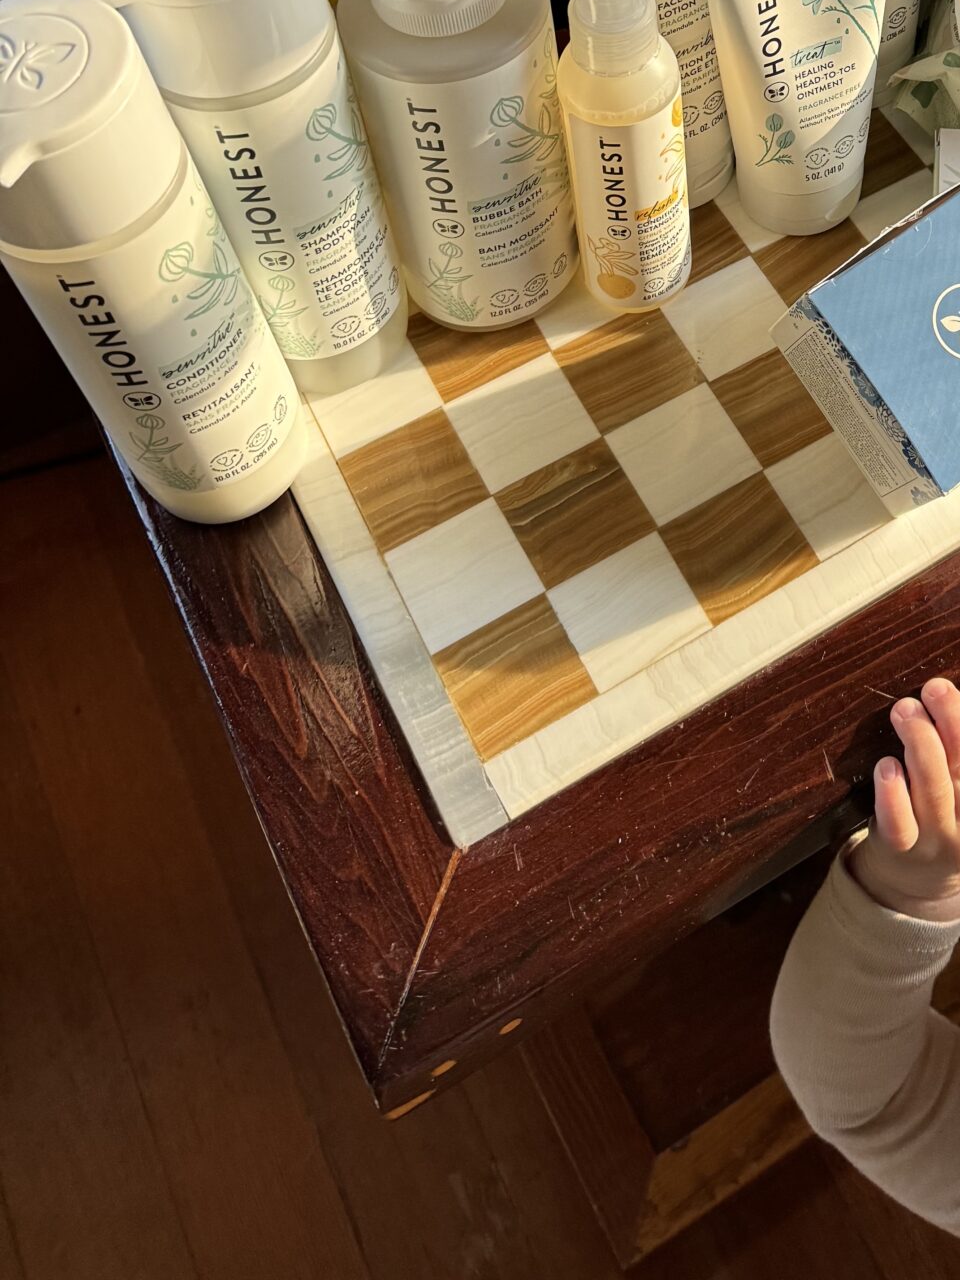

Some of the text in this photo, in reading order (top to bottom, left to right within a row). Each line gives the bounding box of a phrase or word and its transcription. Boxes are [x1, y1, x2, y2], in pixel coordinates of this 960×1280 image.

[658, 0, 697, 20] LOTION
[661, 21, 694, 37] Calendula
[794, 61, 834, 81] HEALING
[795, 63, 857, 91] HEAD-TO-TOE
[797, 78, 844, 100] OINTMENT
[798, 83, 862, 112] FRAGRANCE FREE
[799, 105, 840, 124] Allantoin Skin
[799, 118, 824, 130] without
[408, 99, 458, 213] HONEST
[216, 127, 285, 246] HONEST
[600, 136, 628, 222] HONEST
[811, 171, 823, 180] OZ.
[472, 188, 542, 223] BUBBLE BATH
[474, 205, 531, 231] FRAGRANCE
[300, 213, 357, 251] SHAMPOO
[315, 206, 371, 255] BODY WASH
[474, 211, 536, 238] Calendula Aloe
[478, 207, 559, 255] BAIN MOUSSANT
[308, 253, 347, 275] Calendula
[312, 240, 375, 288] SHAMPOING
[315, 253, 375, 295] NETTOYANT
[480, 254, 519, 268] Calendula
[318, 269, 370, 304] LE CORPS
[322, 295, 360, 317] Calendula
[490, 303, 524, 318] 12.0 OZ.
[57, 276, 148, 387] HONEST
[333, 338, 349, 350] 10.0
[166, 328, 243, 390] CONDITIONER
[170, 357, 232, 398] FRAGRANCE
[174, 360, 239, 405] Calendula Aloe
[182, 362, 256, 422] REVITALISANT
[189, 411, 231, 435] Calendula
[214, 462, 253, 483] 10.0 OZ.
